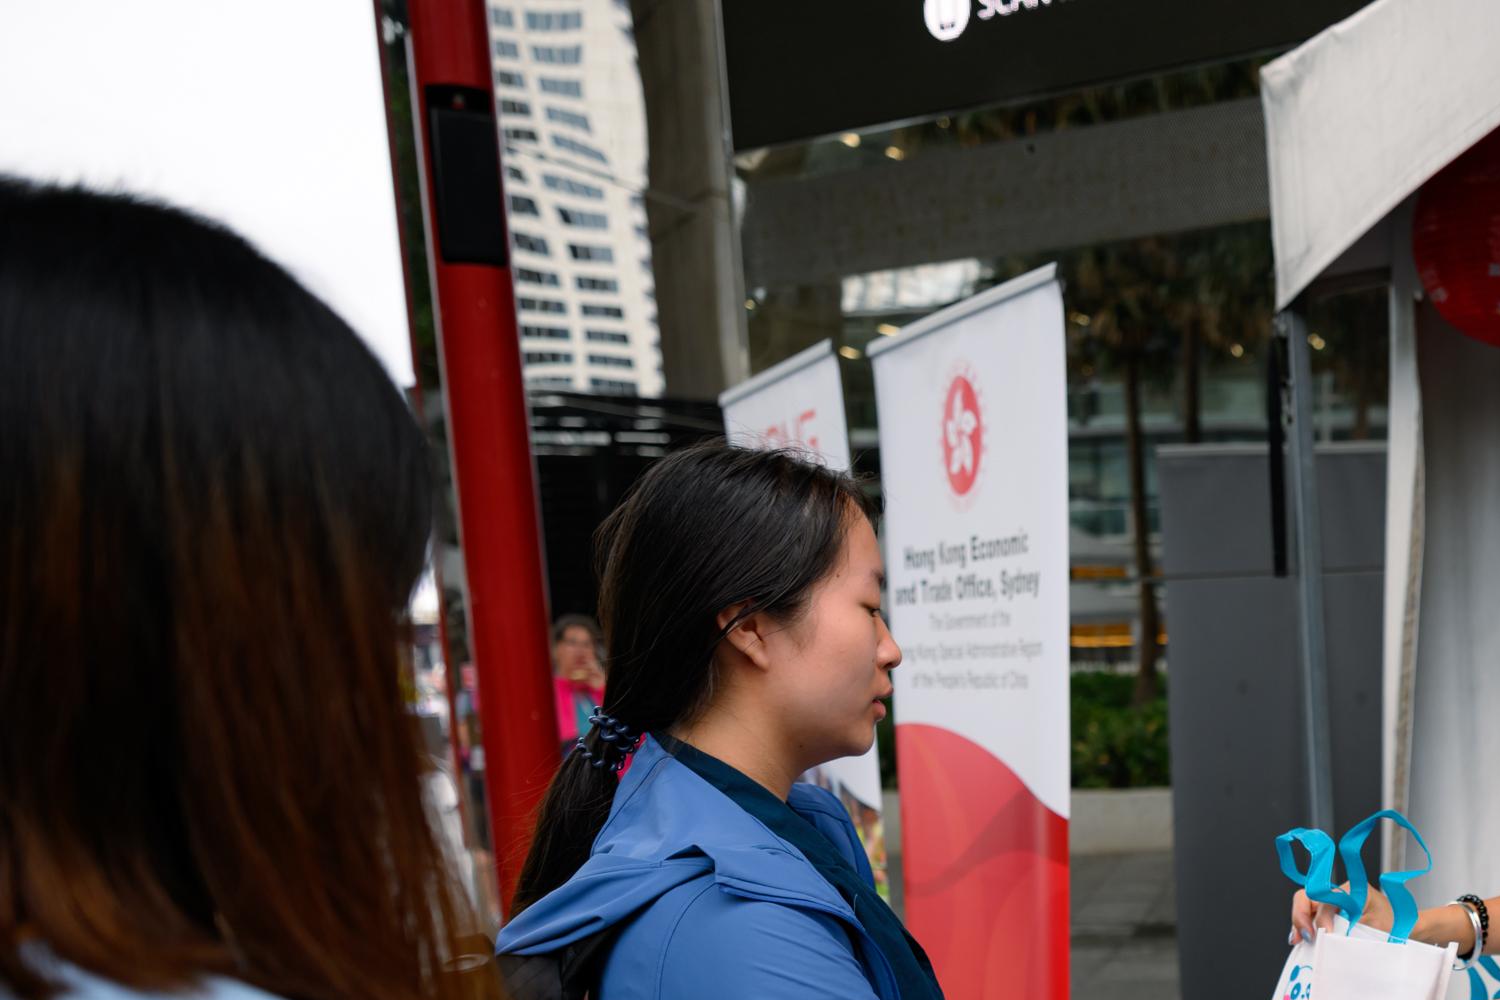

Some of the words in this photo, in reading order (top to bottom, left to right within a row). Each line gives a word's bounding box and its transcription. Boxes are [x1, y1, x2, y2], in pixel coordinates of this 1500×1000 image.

[903, 546, 935, 573] Hong
[939, 540, 966, 568] Kong
[970, 528, 1029, 562] Economic
[895, 581, 916, 606] and
[921, 576, 952, 603] Trade
[1001, 568, 1040, 601] Sydney
